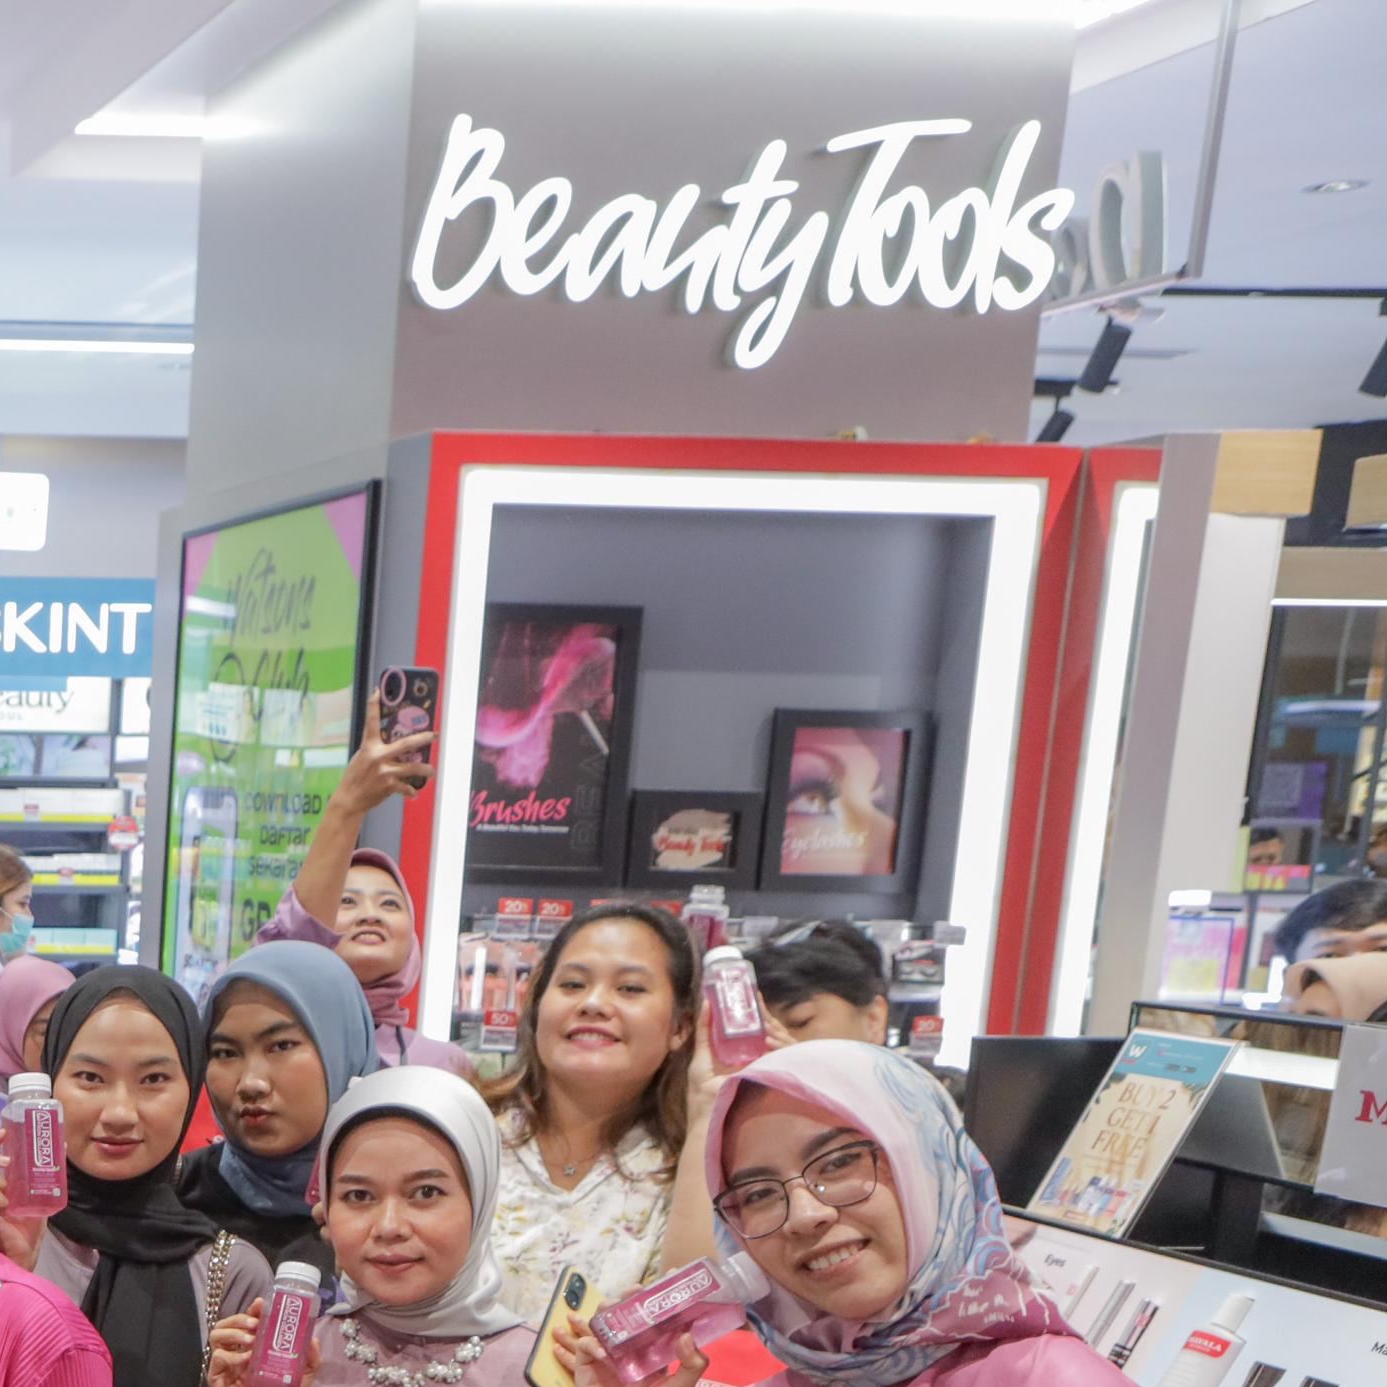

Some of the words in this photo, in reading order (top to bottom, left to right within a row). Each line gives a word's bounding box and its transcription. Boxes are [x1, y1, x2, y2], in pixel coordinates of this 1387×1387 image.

[410, 114, 831, 370] Beauty
[828, 117, 1077, 314] Tools
[471, 790, 571, 828] Brushes
[1119, 1082, 1157, 1104] BUY
[1159, 1089, 1177, 1109] 2
[1107, 1107, 1146, 1130] GET
[37, 1112, 52, 1166] AURORA
[1091, 1130, 1148, 1158] FREE
[1044, 1252, 1067, 1268] Eyes
[278, 1298, 303, 1355] AURORA
